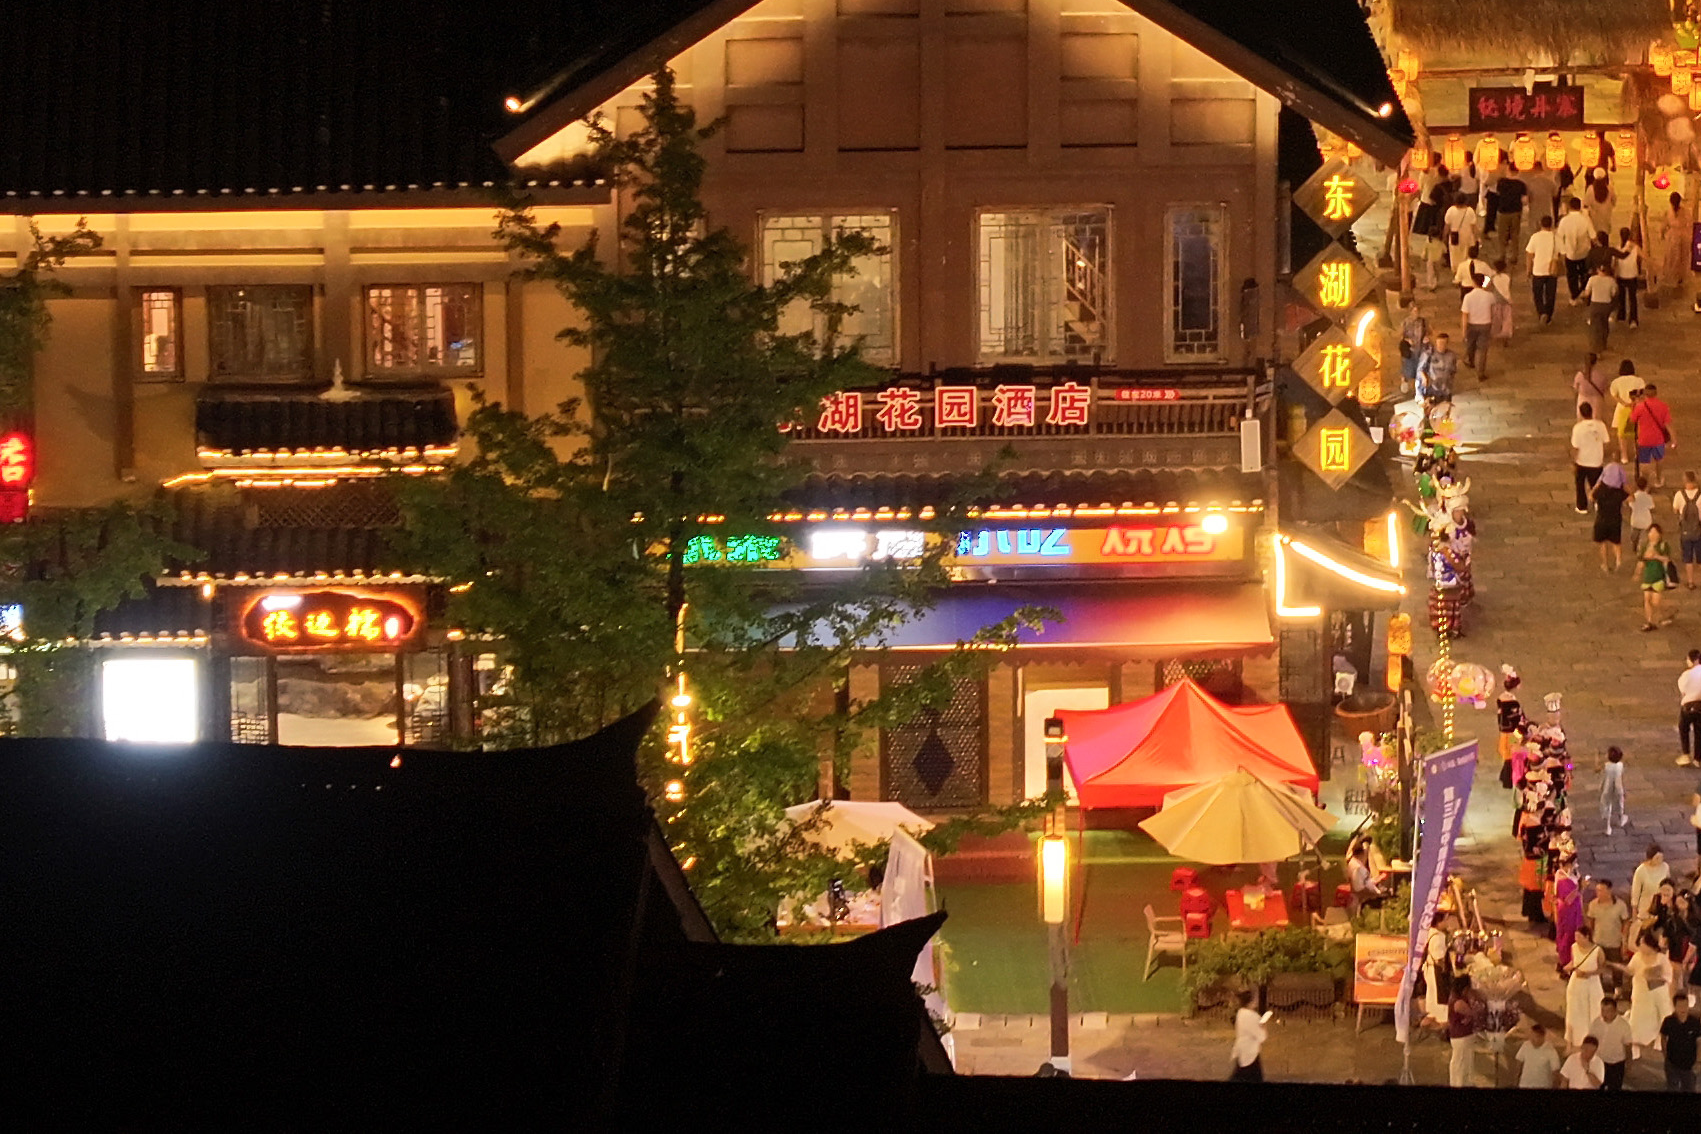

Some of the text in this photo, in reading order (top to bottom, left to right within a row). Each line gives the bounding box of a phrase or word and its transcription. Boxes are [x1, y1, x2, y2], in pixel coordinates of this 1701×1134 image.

[779, 382, 1091, 433] 湖花园酒店
[1320, 174, 1355, 471] 东湖花园
